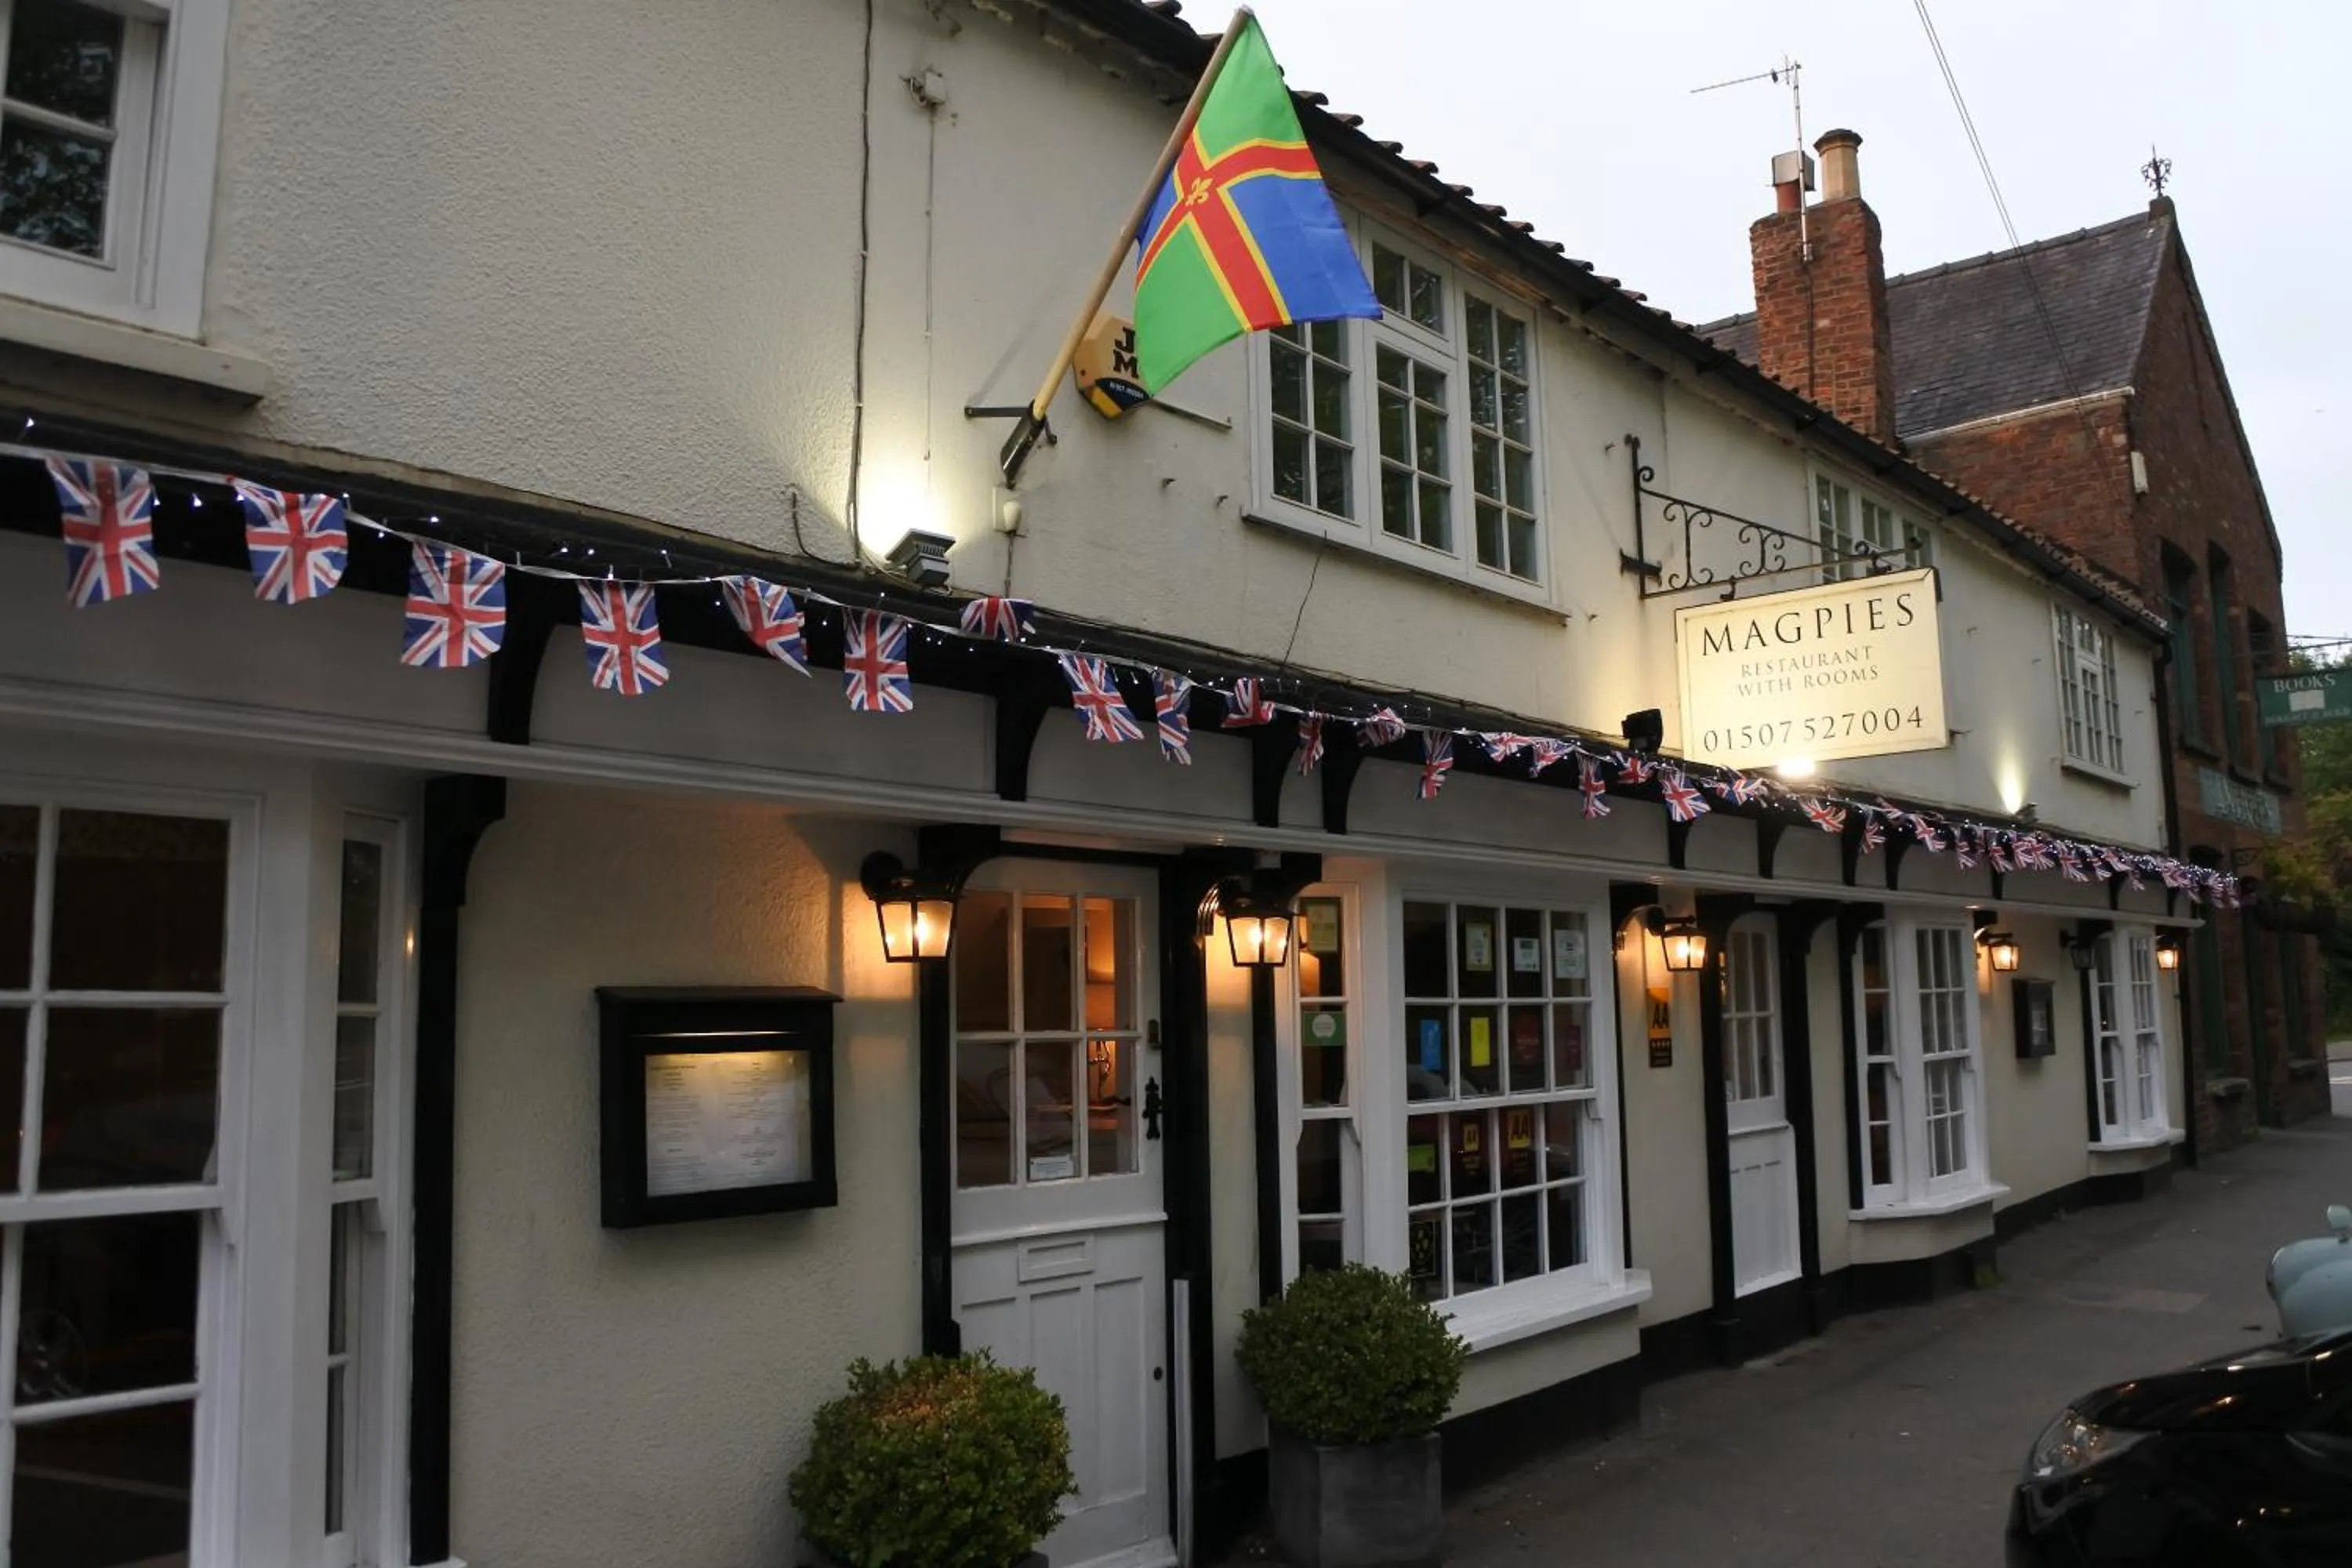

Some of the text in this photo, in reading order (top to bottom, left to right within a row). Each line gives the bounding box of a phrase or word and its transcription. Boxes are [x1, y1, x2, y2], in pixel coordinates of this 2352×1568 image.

[1702, 593, 1915, 656] MAGPIES
[1740, 645, 1874, 679] RESTAURANT
[1737, 665, 1879, 697] WITH ROOMS
[2273, 673, 2336, 693] BOOKS
[1703, 705, 1924, 753] 01507 527004
